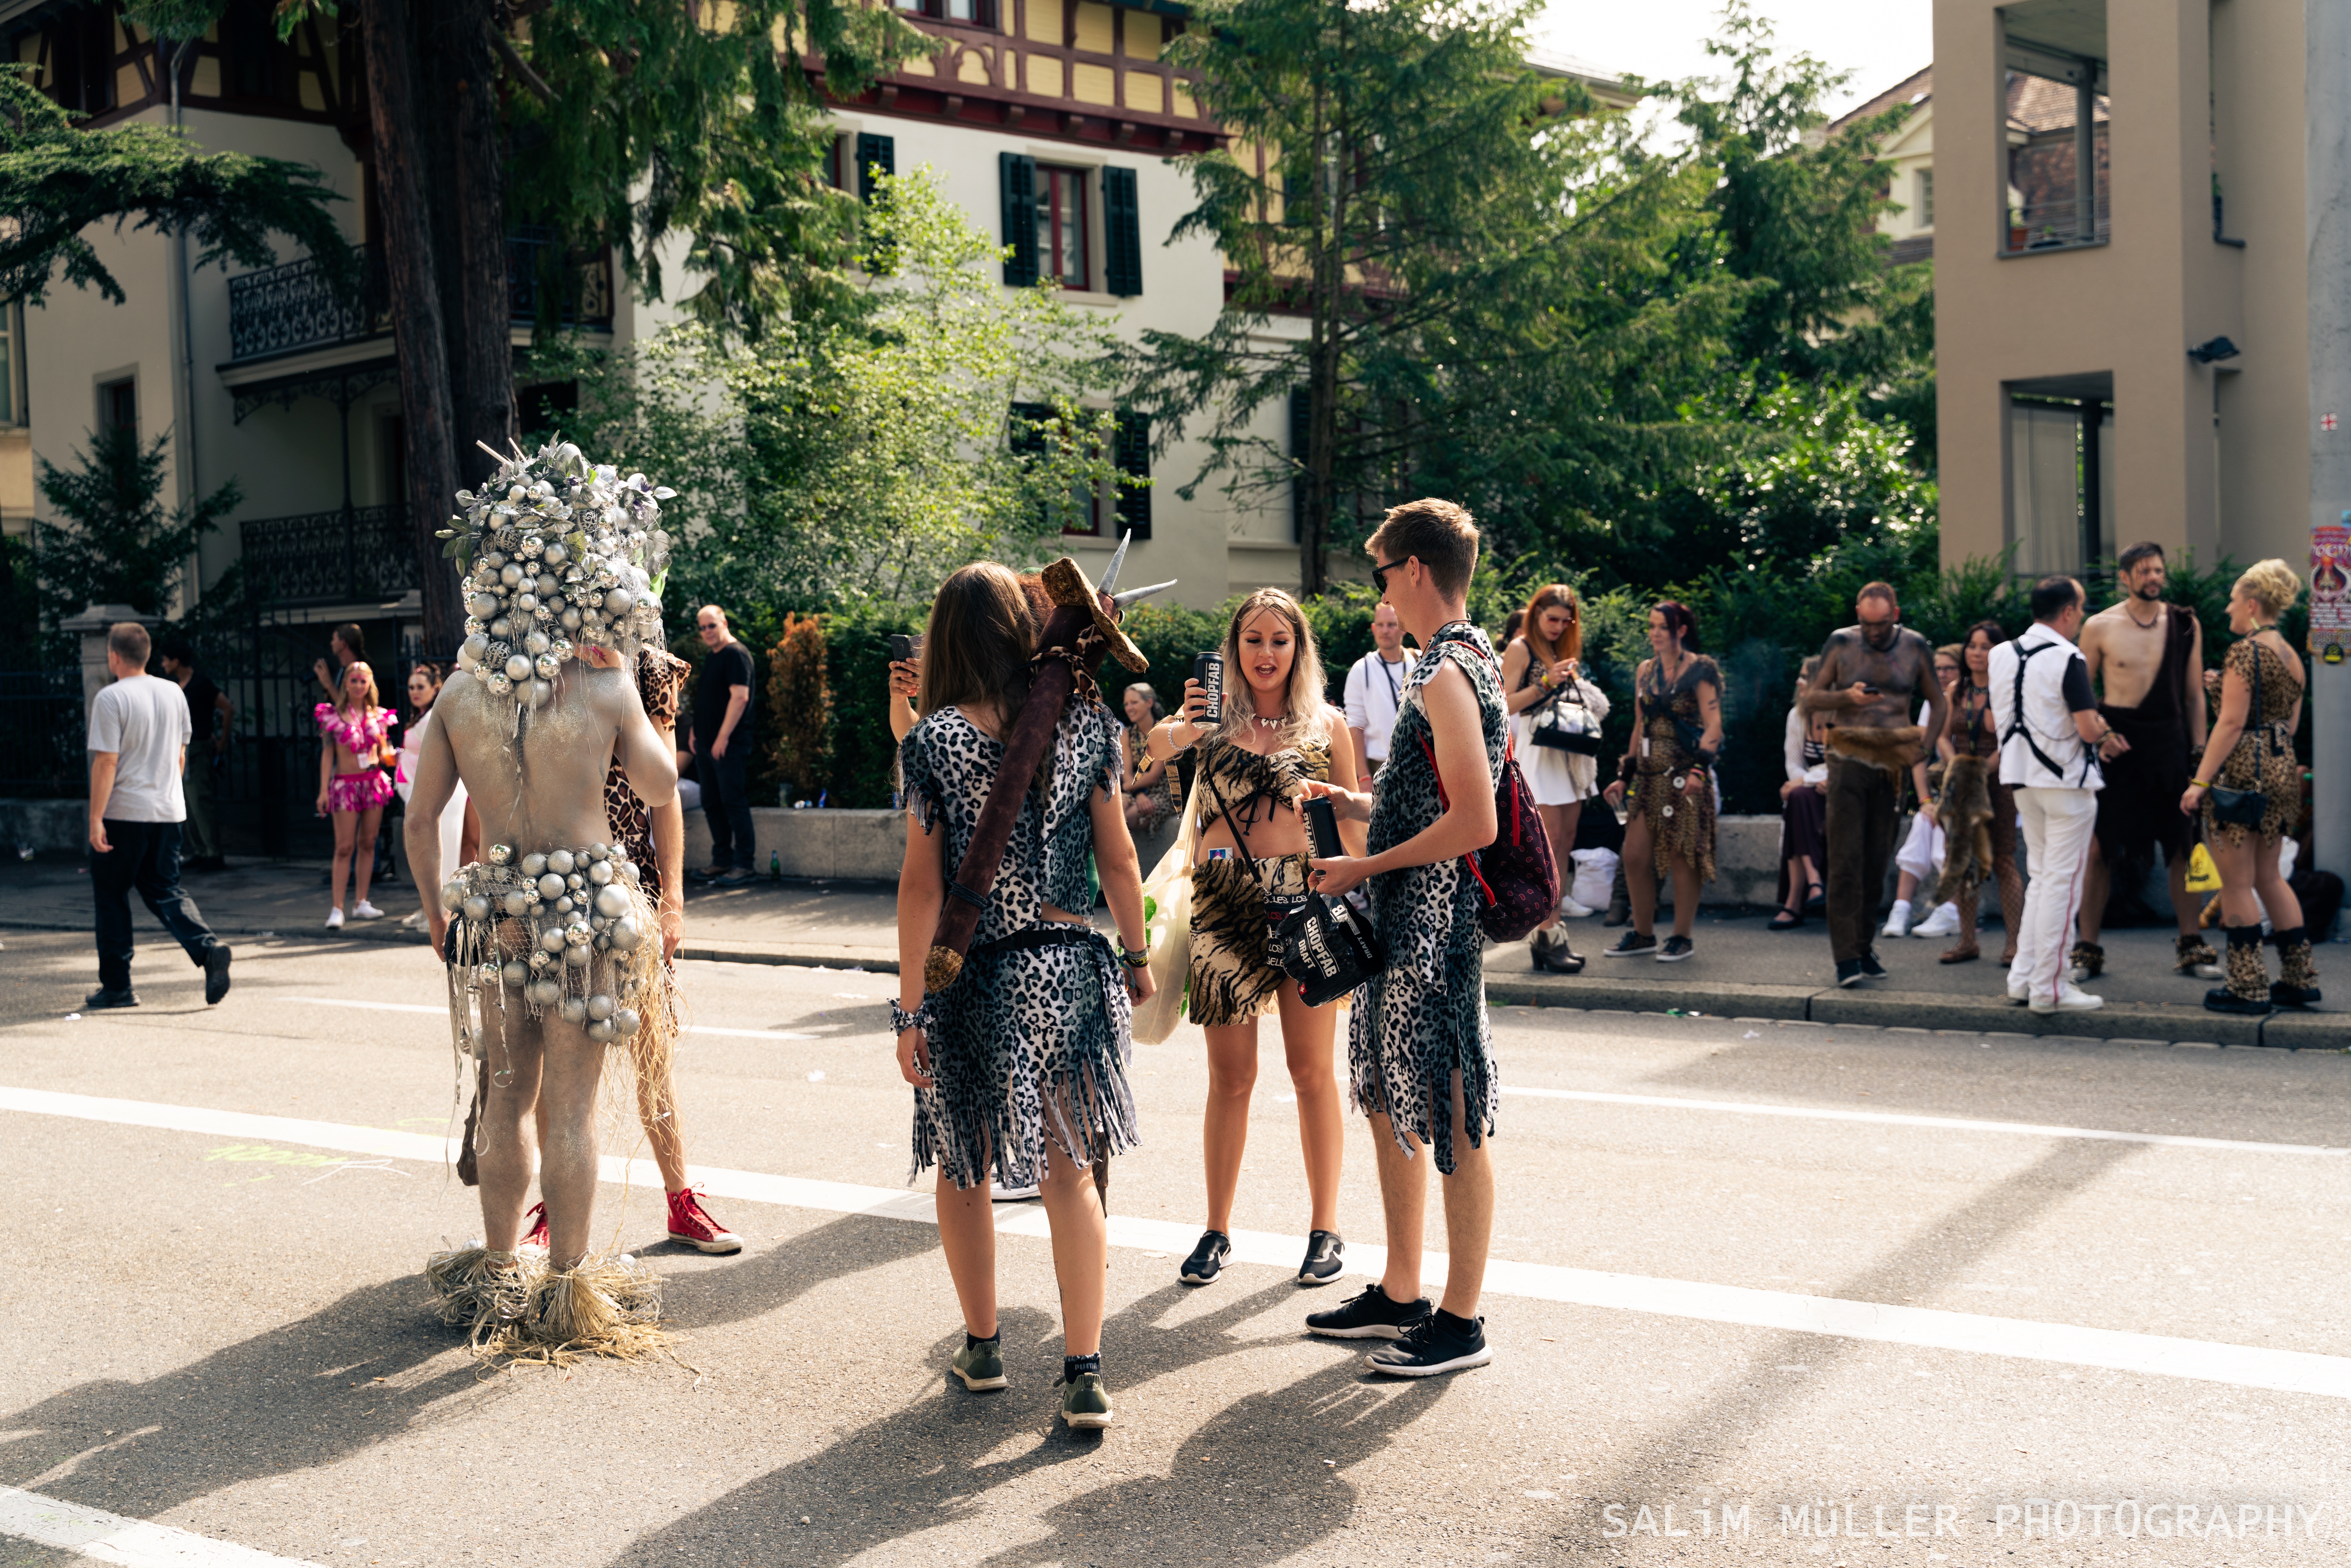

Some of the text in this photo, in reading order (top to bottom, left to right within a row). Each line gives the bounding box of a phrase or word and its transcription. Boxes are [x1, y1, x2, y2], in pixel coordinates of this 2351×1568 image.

[1206, 663, 1220, 718] CHOPFAB
[1303, 812, 1317, 859] HOPFAB
[1268, 912, 1282, 920] LOS
[1268, 943, 1283, 953] LOS
[1298, 939, 1315, 969] DRAFT
[1307, 917, 1337, 977] CHOPFAB
[1357, 937, 1373, 958] DRAFT
